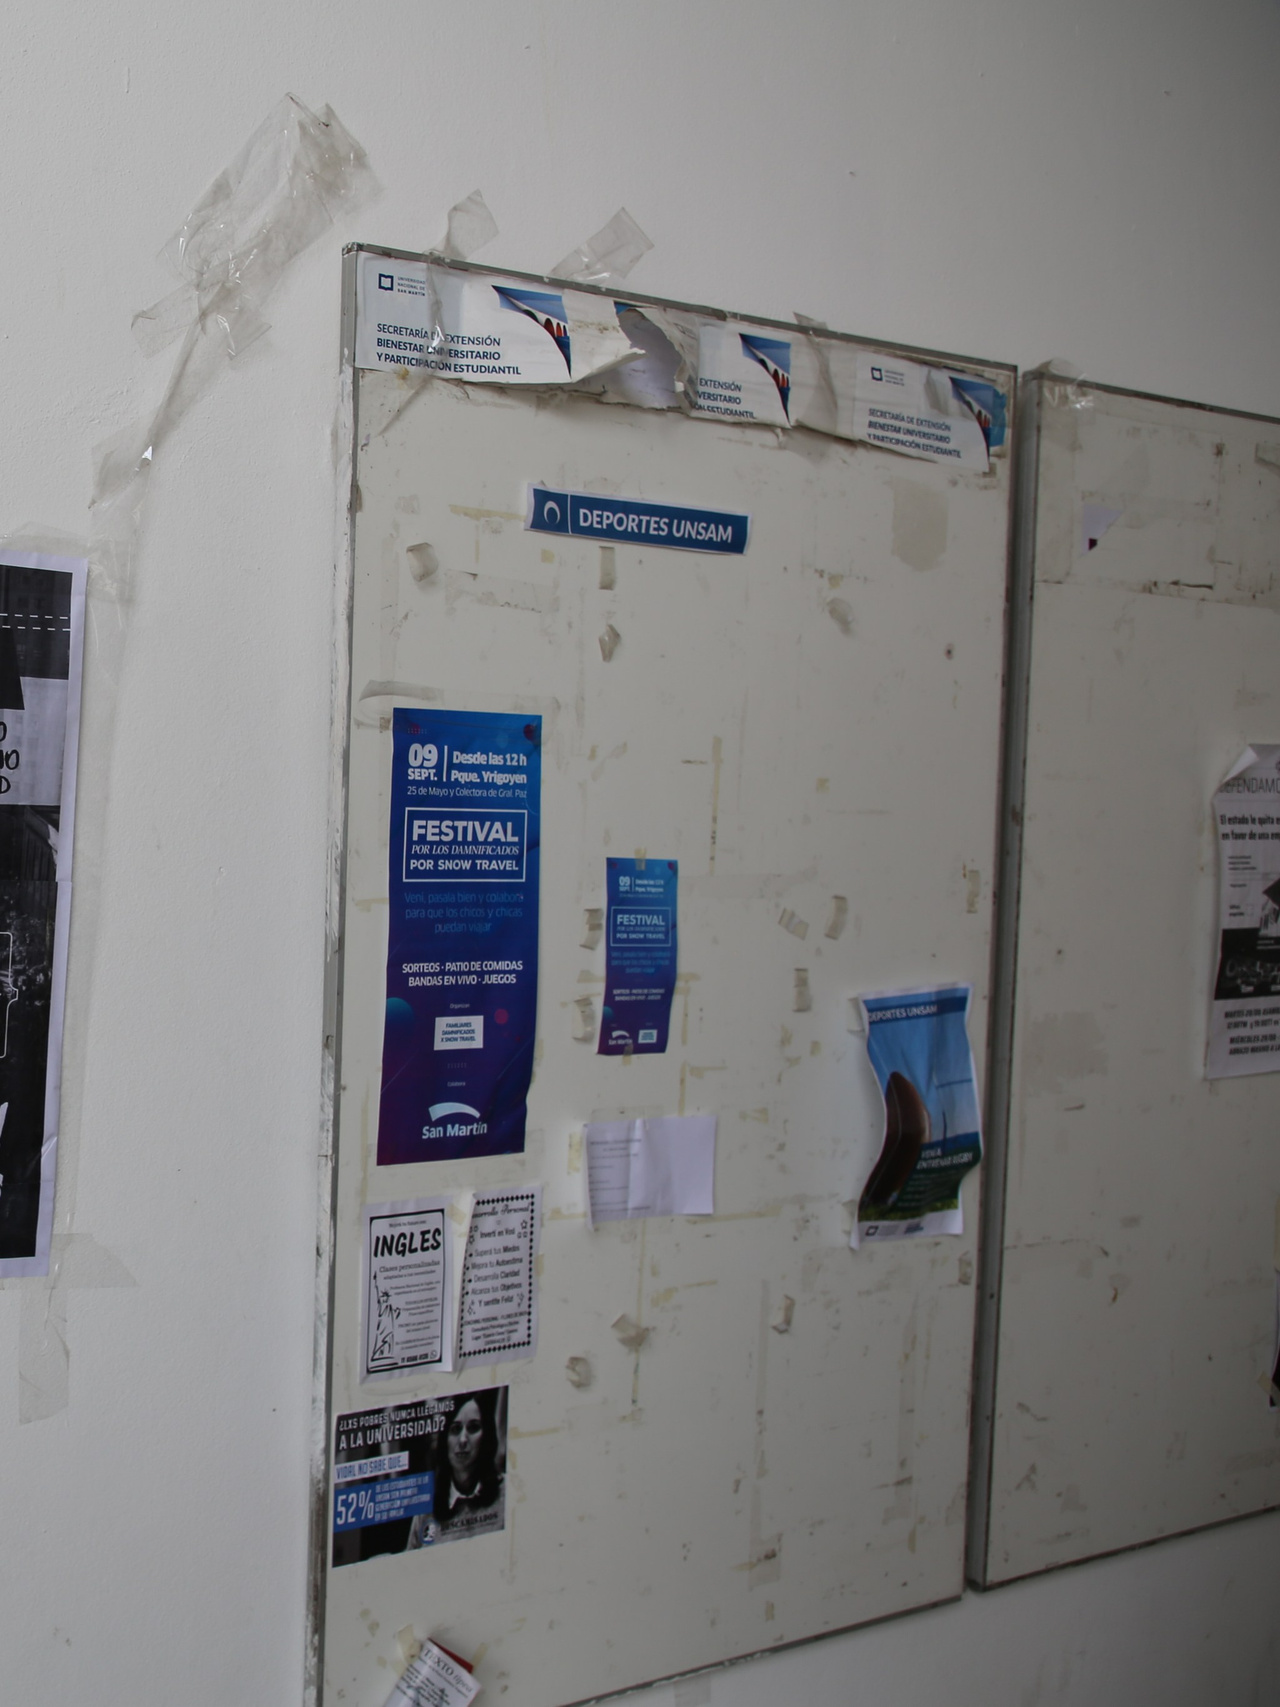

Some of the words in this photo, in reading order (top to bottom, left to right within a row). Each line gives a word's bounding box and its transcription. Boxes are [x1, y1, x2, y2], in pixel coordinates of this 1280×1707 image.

[397, 282, 418, 290] NACIONAL
[377, 323, 429, 340] SECRETARÍA
[446, 333, 501, 347] EXTENSIÓN
[377, 338, 425, 354] BIENESTAR
[377, 352, 383, 362] Y
[384, 354, 452, 372] PARTICIPACIÓN
[453, 364, 522, 375] ESTUDIANTIL
[699, 378, 742, 392] EXTENSIÓN
[868, 408, 906, 422] SECRETARÍA
[906, 416, 914, 424] DE
[916, 418, 952, 432] EXTENSIÓN
[868, 420, 902, 434] BIENESTAR
[902, 428, 951, 444] UNIVERSITARIO
[872, 433, 921, 450] PARTICIPACIÓN
[922, 443, 962, 458] ESTUDIANTIL
[579, 507, 668, 538] DEPORTES
[672, 517, 733, 544] UNSAM
[408, 743, 439, 768] 09
[452, 751, 488, 765] Desde
[488, 752, 504, 766] las
[505, 753, 519, 767] 12
[520, 754, 528, 767] h
[407, 768, 438, 782] SEPT.
[451, 770, 481, 785] Pque.
[482, 770, 528, 786] Yrigoyen
[407, 786, 417, 796] 25
[418, 786, 428, 796] de
[428, 787, 449, 798] Mayo
[449, 790, 455, 798] y
[455, 787, 488, 798] Colectora
[488, 788, 498, 798] de
[498, 788, 514, 798] Gral.
[515, 789, 528, 799] Paz
[1227, 814, 1249, 825] estado
[1250, 814, 1256, 825] le
[1258, 815, 1274, 828] quita
[412, 819, 519, 843] FESTIVAL
[1231, 830, 1247, 840] favor
[1248, 830, 1256, 840] de
[1258, 832, 1270, 840] una
[411, 844, 430, 856] POR
[432, 844, 450, 856] LOS
[451, 845, 520, 857] DAMNIFICADOS
[410, 860, 434, 871] POR
[438, 860, 472, 871] SNOW
[475, 860, 519, 871] TRAVEL
[618, 876, 631, 887] 09
[457, 892, 476, 904] bien
[478, 894, 485, 905] y
[405, 908, 426, 920] para
[427, 908, 444, 920] que
[445, 906, 459, 918] los
[459, 906, 486, 918] chicos
[487, 908, 494, 919] y
[495, 906, 524, 918] chicas
[616, 914, 666, 926] FESTIVAL
[434, 922, 467, 935] puedan
[468, 922, 493, 934] viajar
[402, 962, 440, 974] SORTEOS
[444, 961, 470, 972] PATIO
[470, 961, 482, 972] DE
[482, 960, 524, 972] COMIDAS
[408, 976, 443, 988] BANDAS
[443, 975, 456, 986] EN
[456, 974, 478, 986] VIVO
[482, 974, 517, 985] JUEGOS
[422, 1126, 444, 1140] San
[446, 1121, 488, 1138] Martín
[374, 1228, 442, 1258] INGLES
[502, 1244, 520, 1253] Miedos
[379, 1264, 398, 1274] Clases
[338, 1419, 358, 1432] ¿LXS
[359, 1414, 389, 1428] POBRES
[390, 1410, 416, 1422] NUNCA
[416, 1400, 456, 1418] LLEGAMOS
[339, 1434, 348, 1451] A
[350, 1432, 364, 1449] LA
[366, 1416, 447, 1446] UNIVERSIDAD?
[336, 1465, 356, 1480] VIDAL
[358, 1462, 369, 1476] NO
[369, 1459, 386, 1474] SABE
[336, 1489, 375, 1526] 52%
